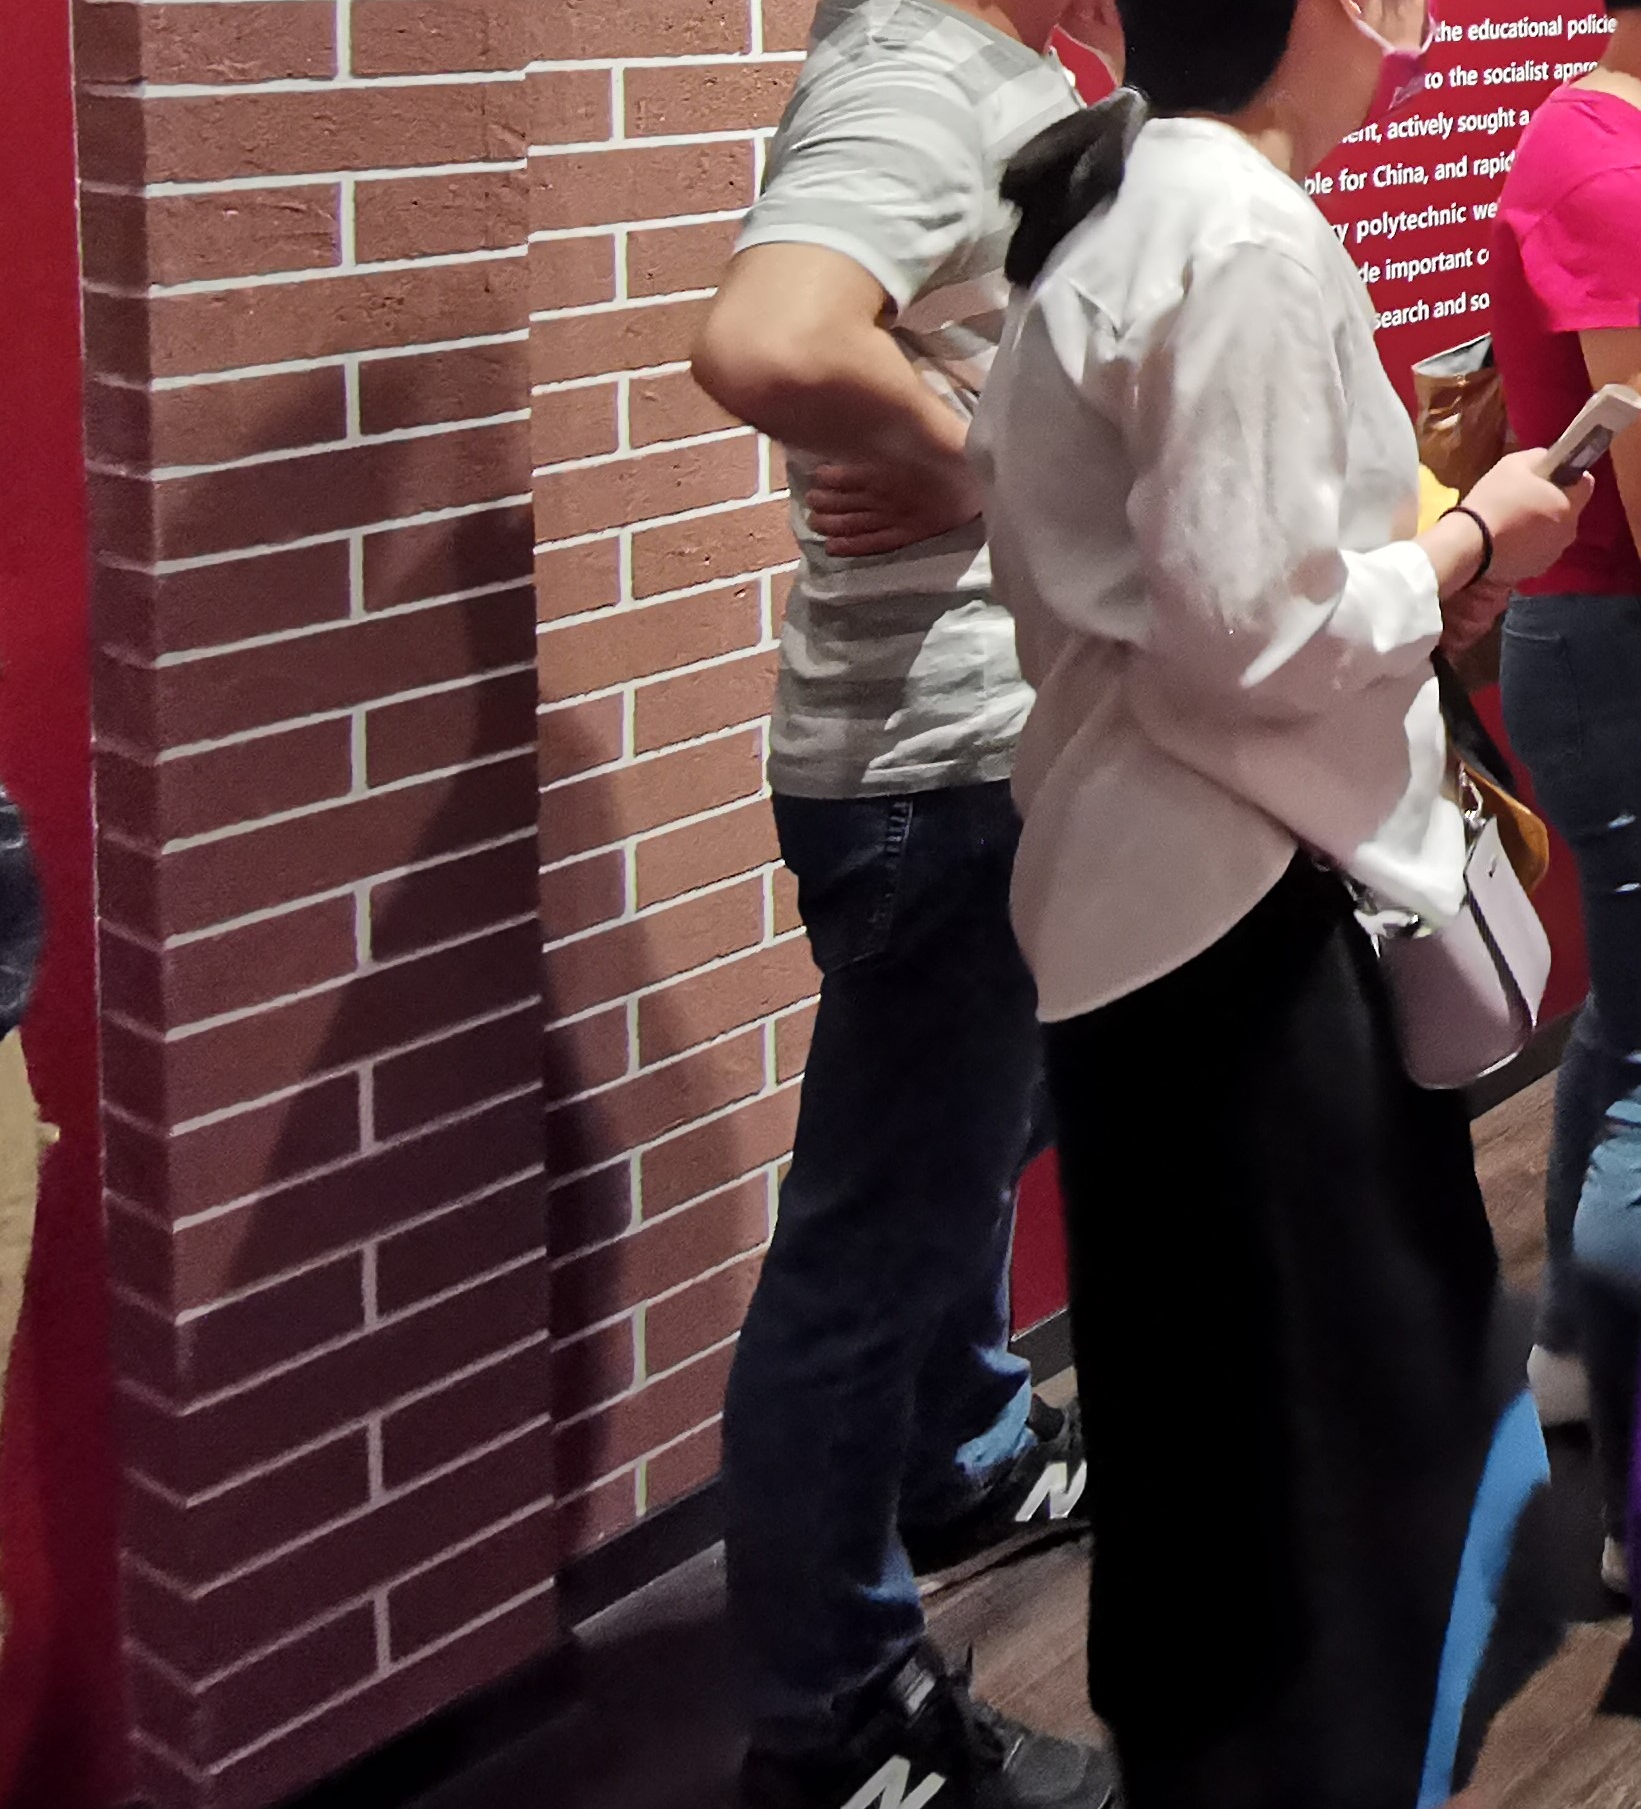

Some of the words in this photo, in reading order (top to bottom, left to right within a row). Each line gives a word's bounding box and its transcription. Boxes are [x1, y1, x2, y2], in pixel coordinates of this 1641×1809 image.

[1468, 15, 1562, 41] educational
[1449, 65, 1478, 87] the
[1483, 60, 1549, 84] socialist
[1387, 112, 1453, 140] actively
[1457, 107, 1516, 135] sought
[1519, 109, 1530, 126] a
[1338, 168, 1367, 191] for
[1372, 162, 1429, 187] China,
[1434, 155, 1468, 181] and
[1356, 202, 1467, 243] polytechnic
[1385, 248, 1473, 282] important
[1433, 292, 1467, 319] and
